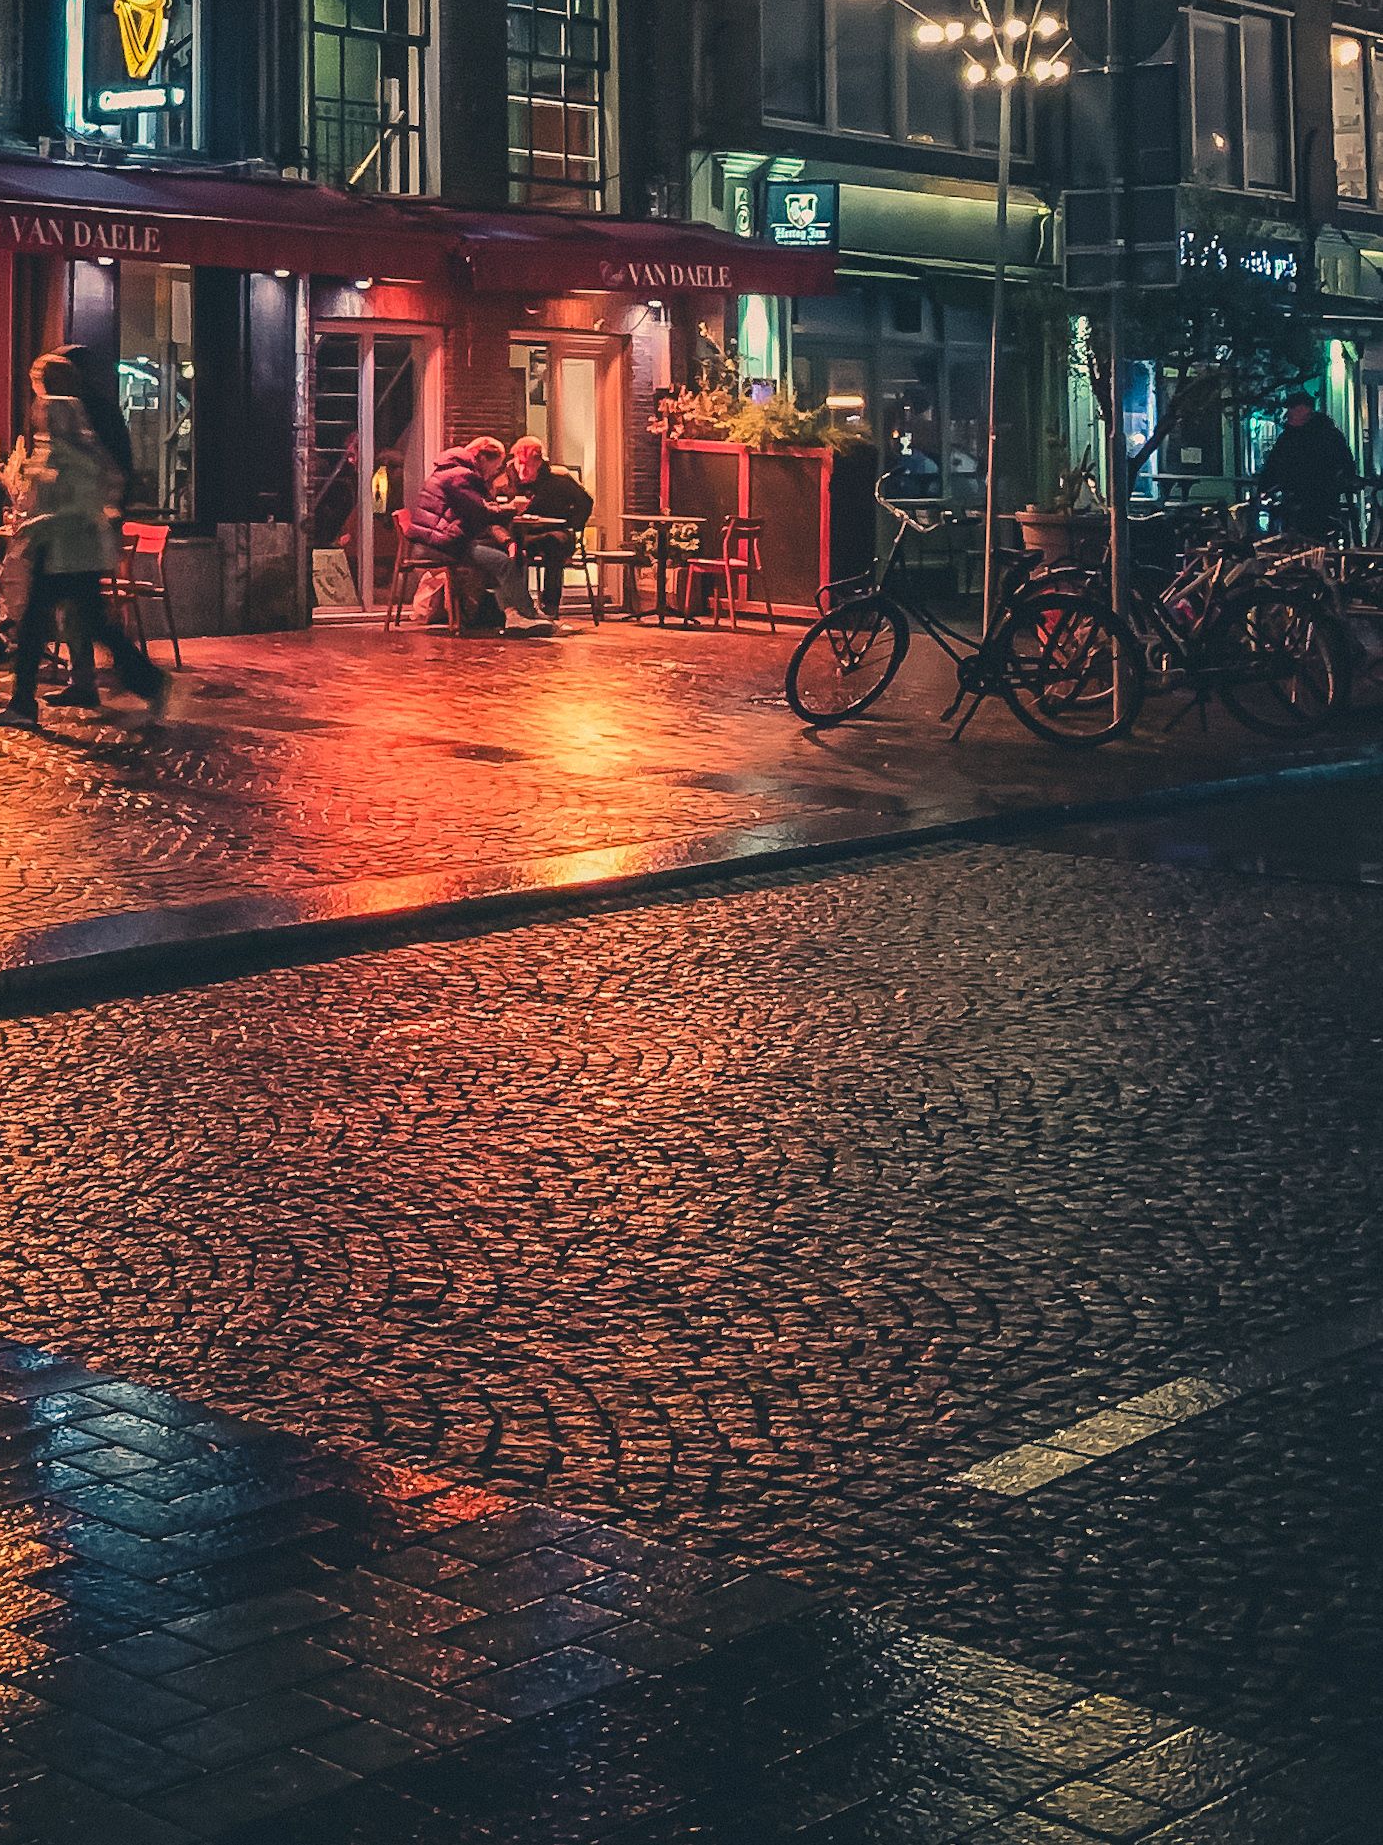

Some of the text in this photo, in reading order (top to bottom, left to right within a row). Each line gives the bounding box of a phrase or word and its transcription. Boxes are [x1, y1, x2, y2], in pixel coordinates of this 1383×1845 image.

[9, 215, 64, 246] VAN
[73, 220, 161, 253] DAELE
[628, 262, 666, 287] VAN
[669, 263, 733, 289] DAELE
